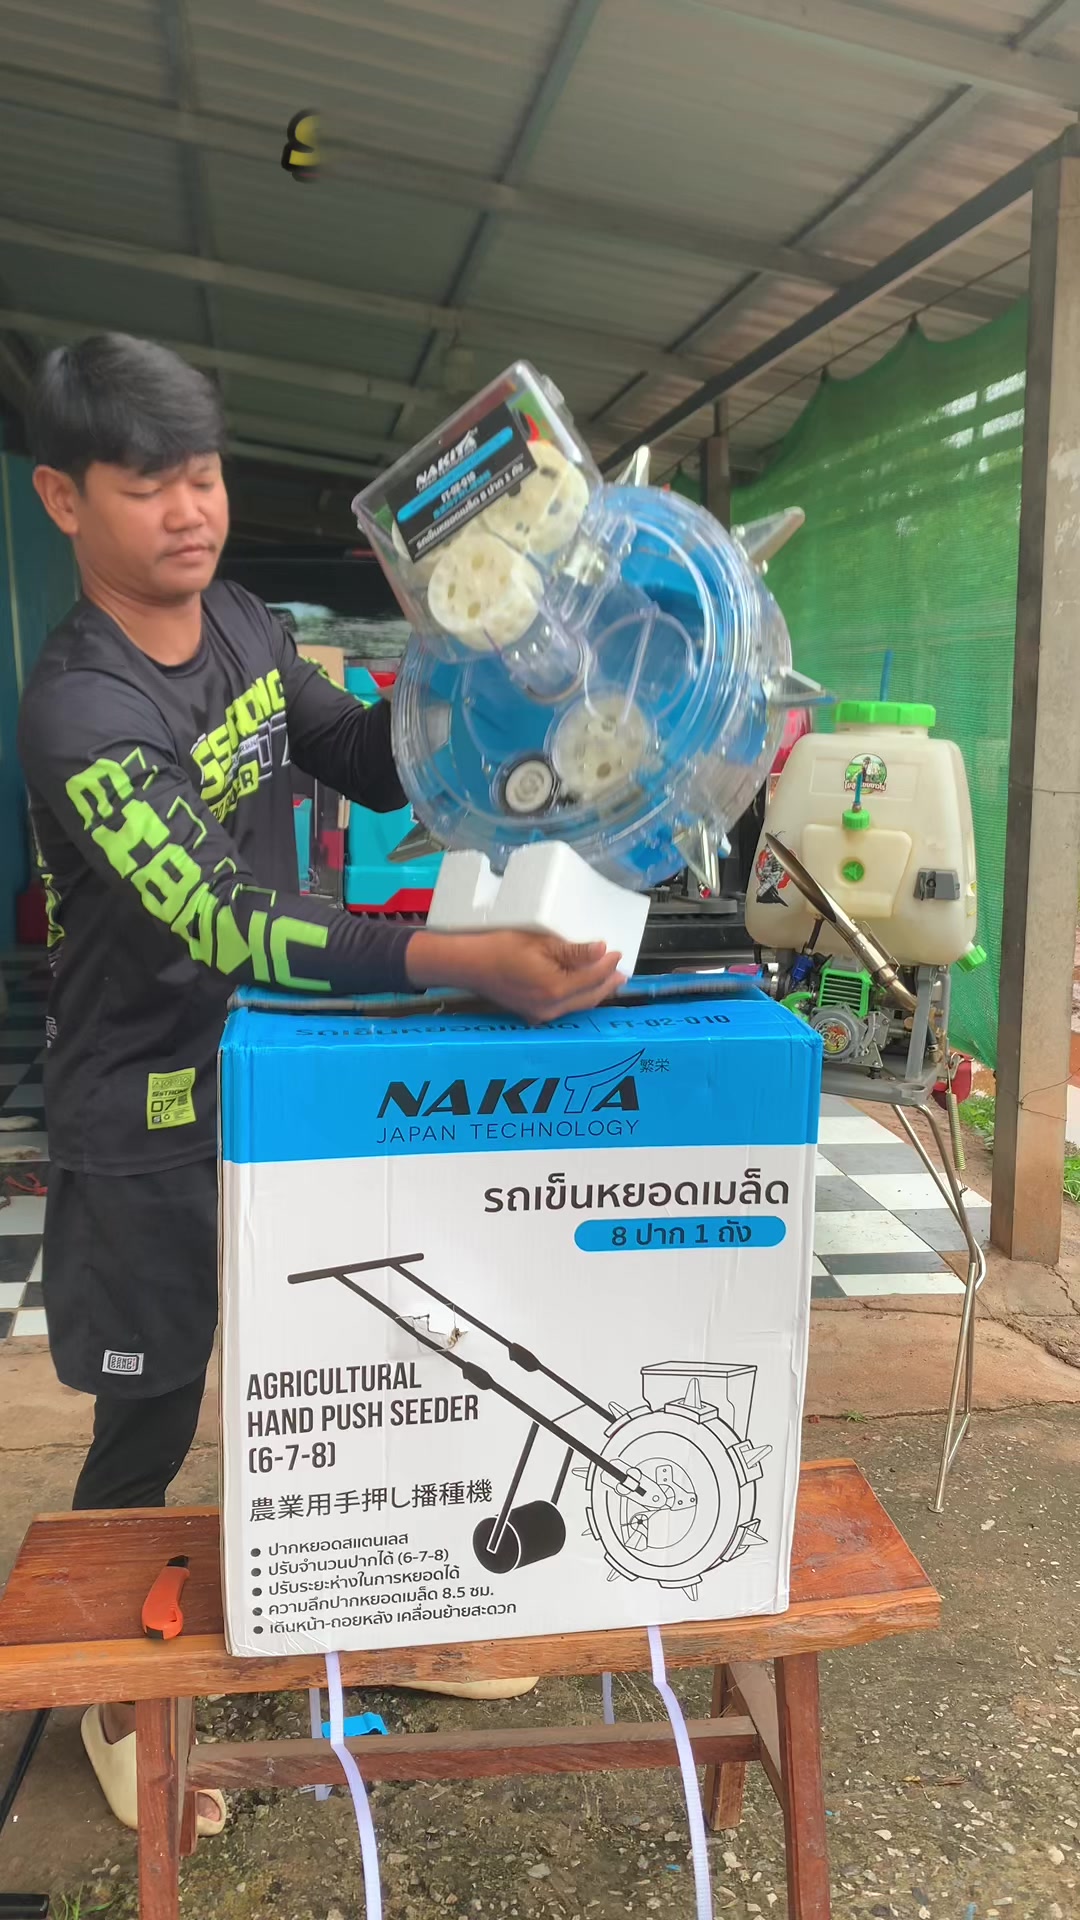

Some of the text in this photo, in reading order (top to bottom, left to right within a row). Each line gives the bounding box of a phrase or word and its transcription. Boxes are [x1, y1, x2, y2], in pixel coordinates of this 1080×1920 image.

[608, 1014, 731, 1030] FT-02-010
[640, 1058, 670, 1073] 繁栄
[376, 1047, 646, 1118] NAKITA
[151, 1098, 176, 1112] 07
[376, 1119, 640, 1144] JAPAN TECHNOLOGY
[484, 1168, 789, 1213] รถเข็นหยอดเมล็ด
[611, 1219, 752, 1246] 8 ปาก 1 ถัง
[246, 1362, 422, 1401] AGRICULTURAL
[247, 1394, 479, 1437] HAND PUSH SEEDER
[248, 1441, 336, 1474] (6-7-8)
[249, 1478, 493, 1522] 農業用手押し播種機
[268, 1533, 408, 1556] ปากหยอดสแตนเลส
[268, 1548, 449, 1576] ปรับจำนวนปากได้ (6-7-8)
[268, 1564, 460, 1595] ปรับระยะห่างในการหยอดได้
[268, 1585, 494, 1615] ความลึกปากหยอดเมล็ด 8.5 ซม.
[397, 1603, 517, 1623] เคลื่อนย้ายสะดวก
